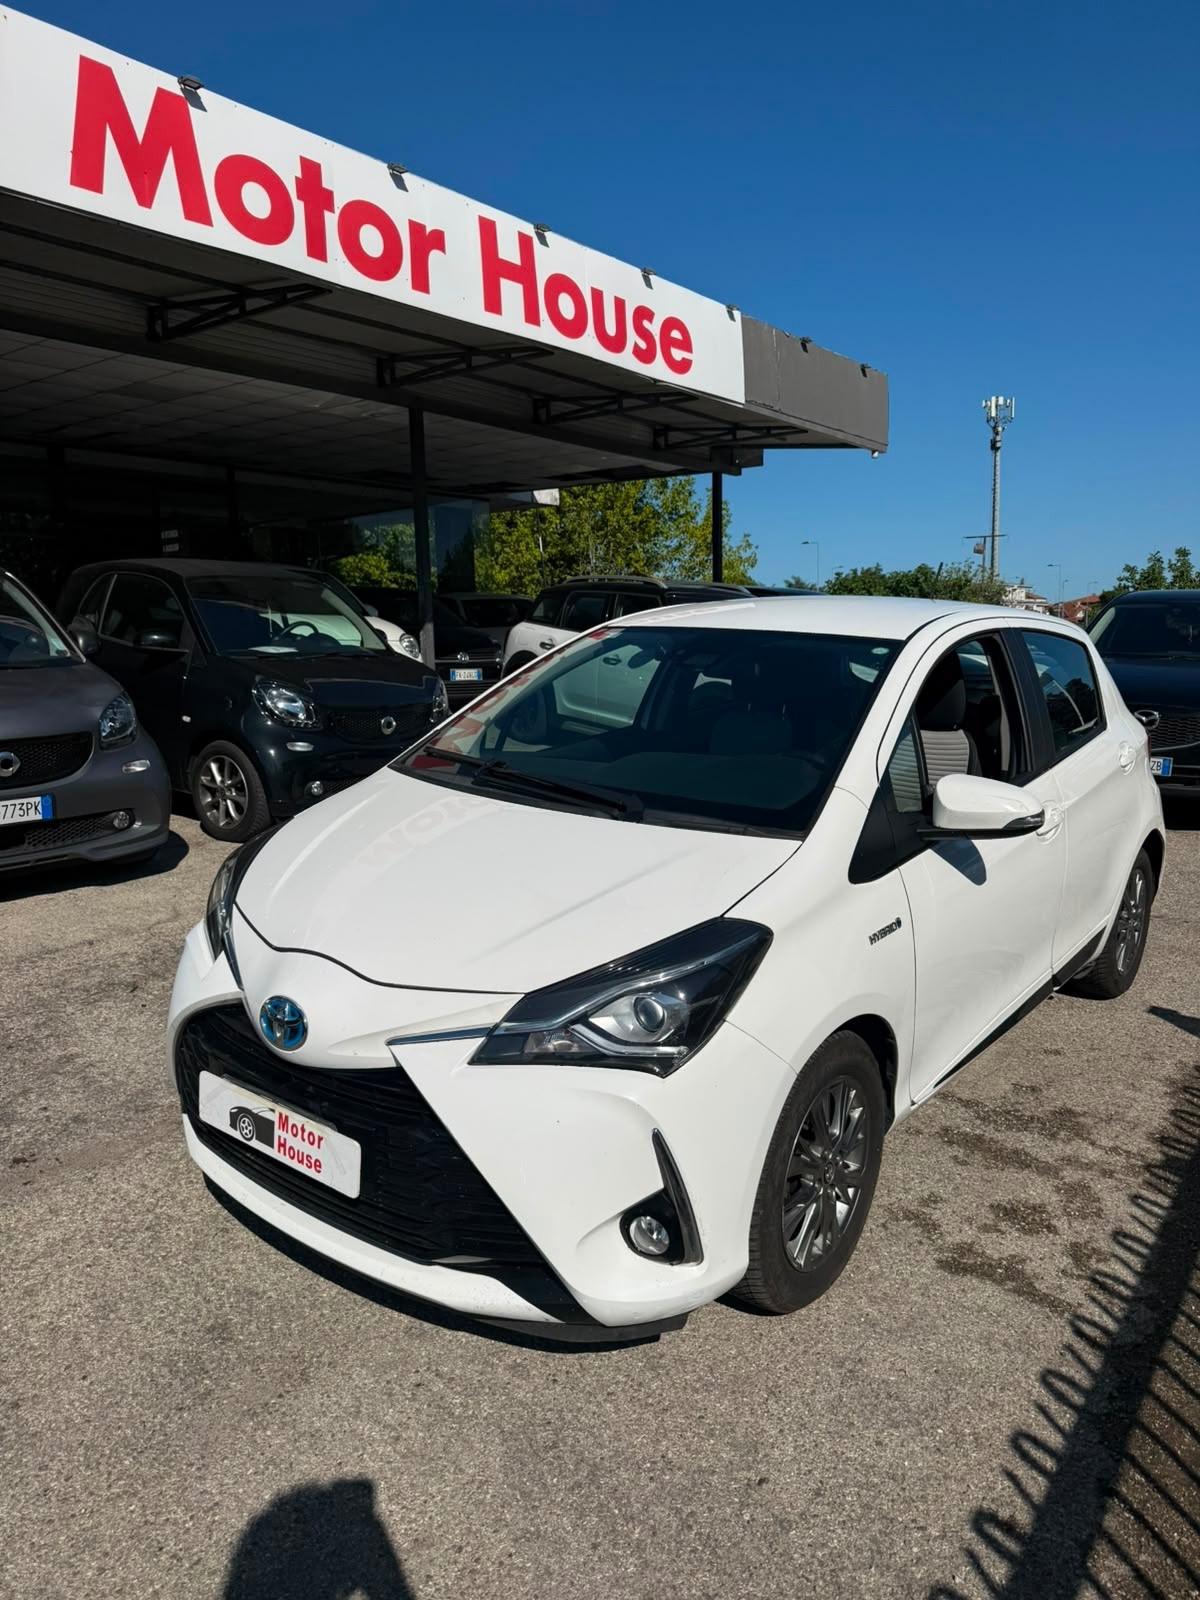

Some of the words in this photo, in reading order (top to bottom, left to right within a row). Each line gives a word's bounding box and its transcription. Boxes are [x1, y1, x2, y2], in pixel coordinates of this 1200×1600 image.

[69, 54, 446, 294] Motor
[478, 215, 694, 375] House
[868, 921, 898, 946] HYBRID
[278, 1111, 324, 1149] Motor
[277, 1135, 322, 1173] House
